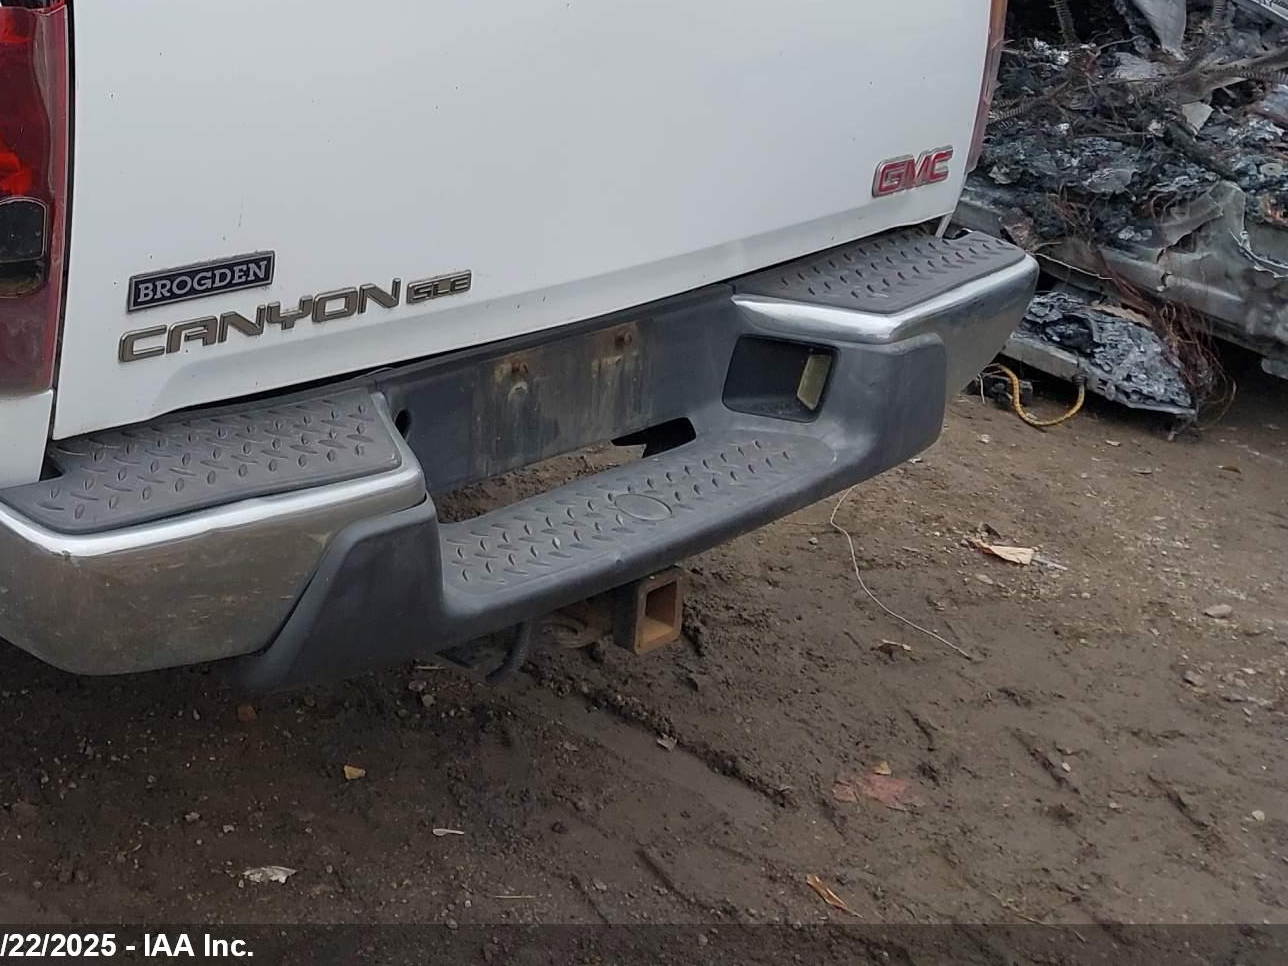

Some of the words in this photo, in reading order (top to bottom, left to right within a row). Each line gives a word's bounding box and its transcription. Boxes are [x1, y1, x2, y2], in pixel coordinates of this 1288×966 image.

[872, 145, 954, 198] GMC
[138, 261, 268, 303] BROGDEN
[119, 278, 401, 362] CANYON
